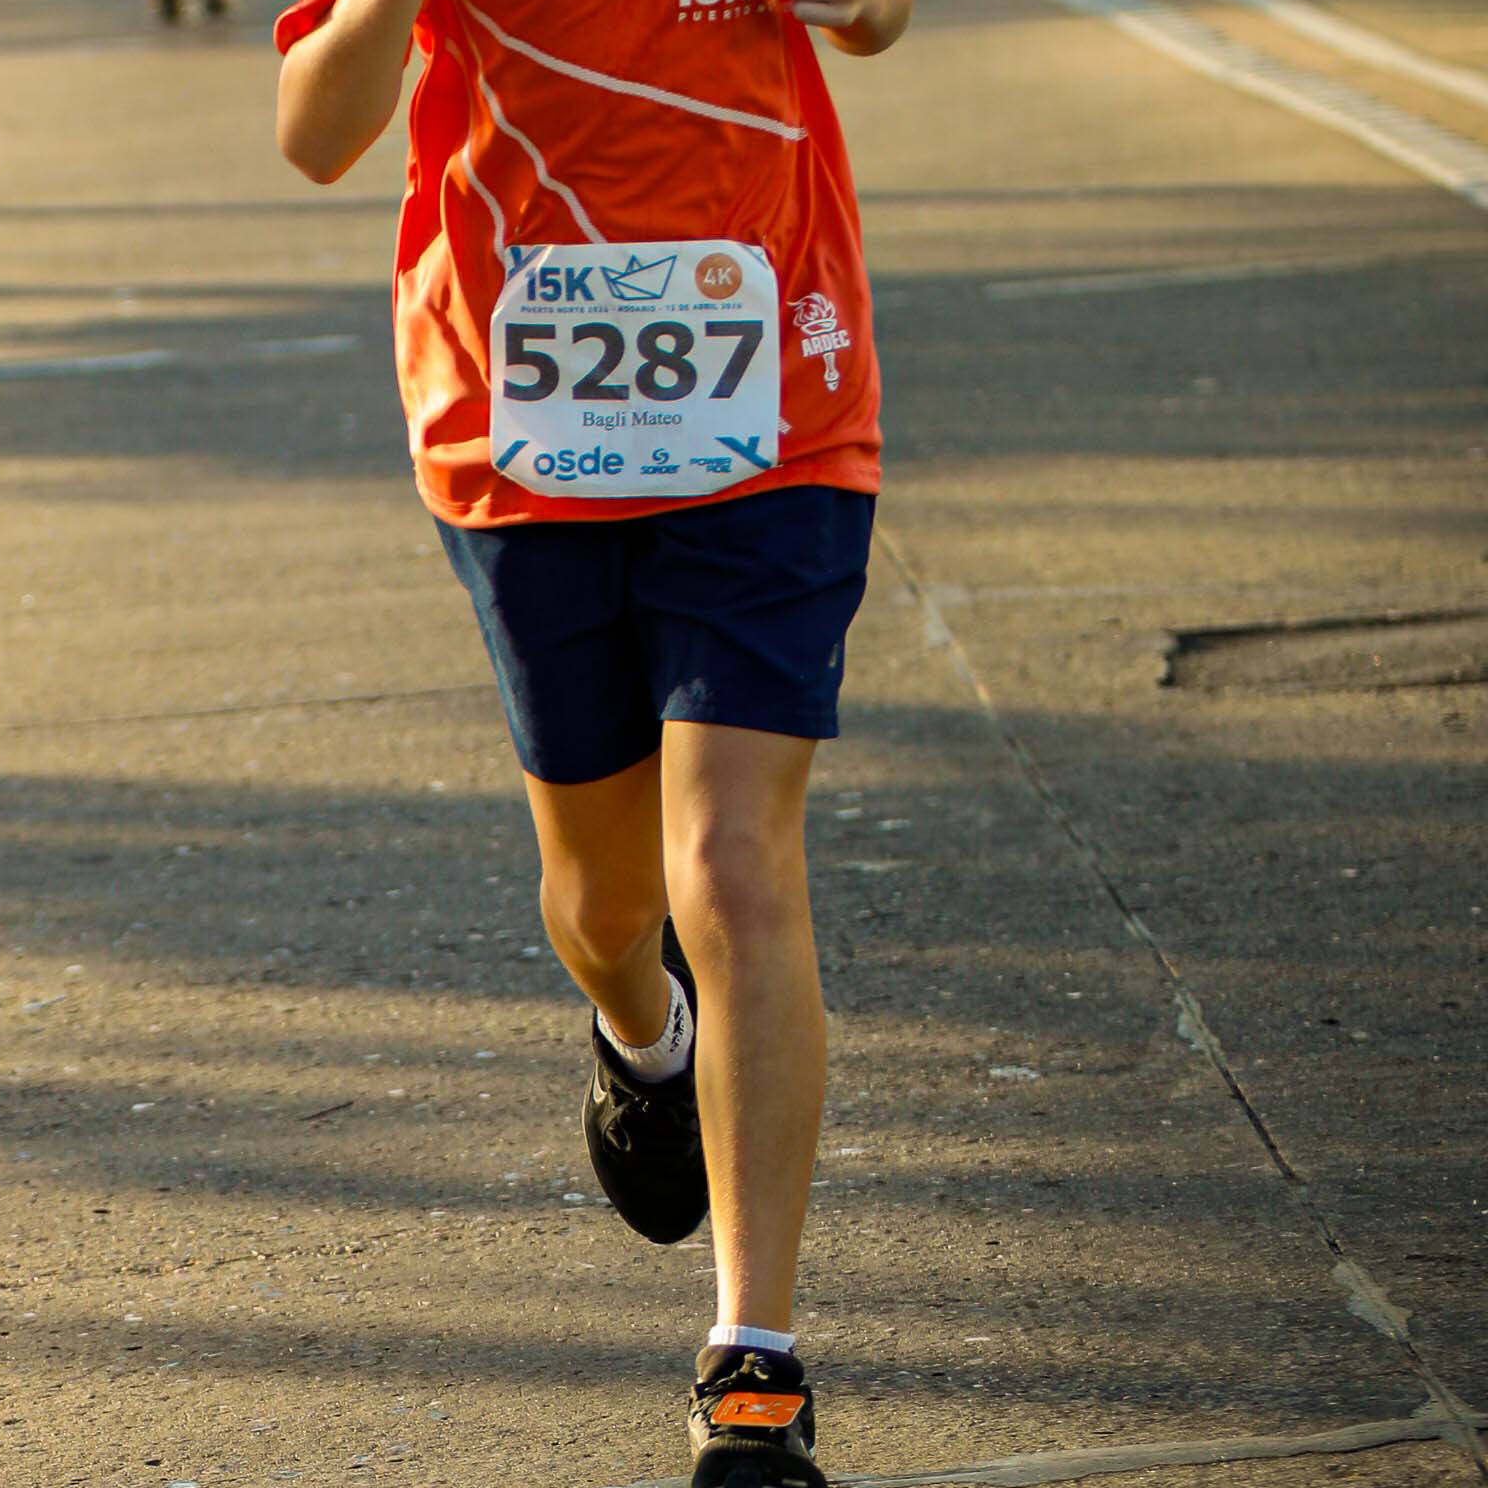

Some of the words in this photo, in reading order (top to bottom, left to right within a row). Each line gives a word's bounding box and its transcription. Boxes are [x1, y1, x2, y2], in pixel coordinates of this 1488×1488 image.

[525, 266, 594, 302] 15K
[703, 266, 733, 286] 4K
[801, 329, 850, 358] ARDEC
[503, 320, 763, 402] 5287
[582, 411, 626, 430] Bagli
[631, 411, 682, 427] Mateo
[533, 445, 625, 480] osde
